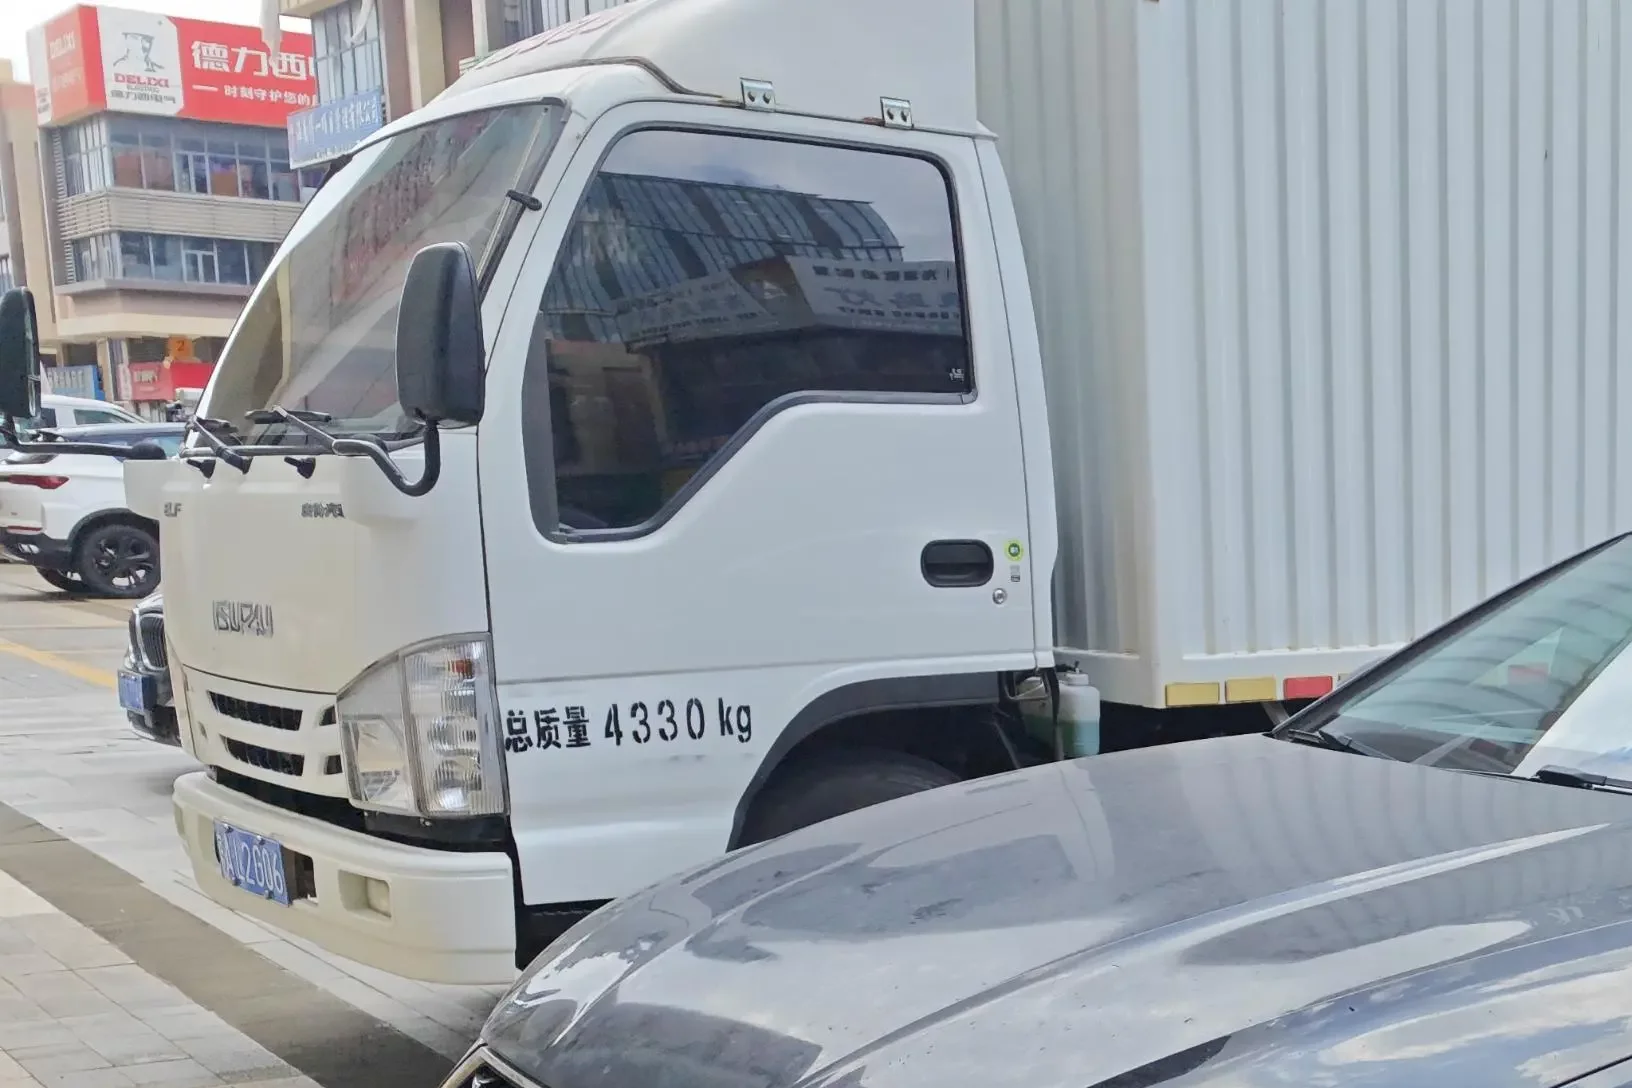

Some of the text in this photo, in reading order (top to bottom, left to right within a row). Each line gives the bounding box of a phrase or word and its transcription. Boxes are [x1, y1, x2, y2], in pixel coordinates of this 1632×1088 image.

[114, 72, 170, 88] DELIXI
[191, 40, 315, 81] 德力西
[504, 697, 752, 752] 总质量 4330 kg
